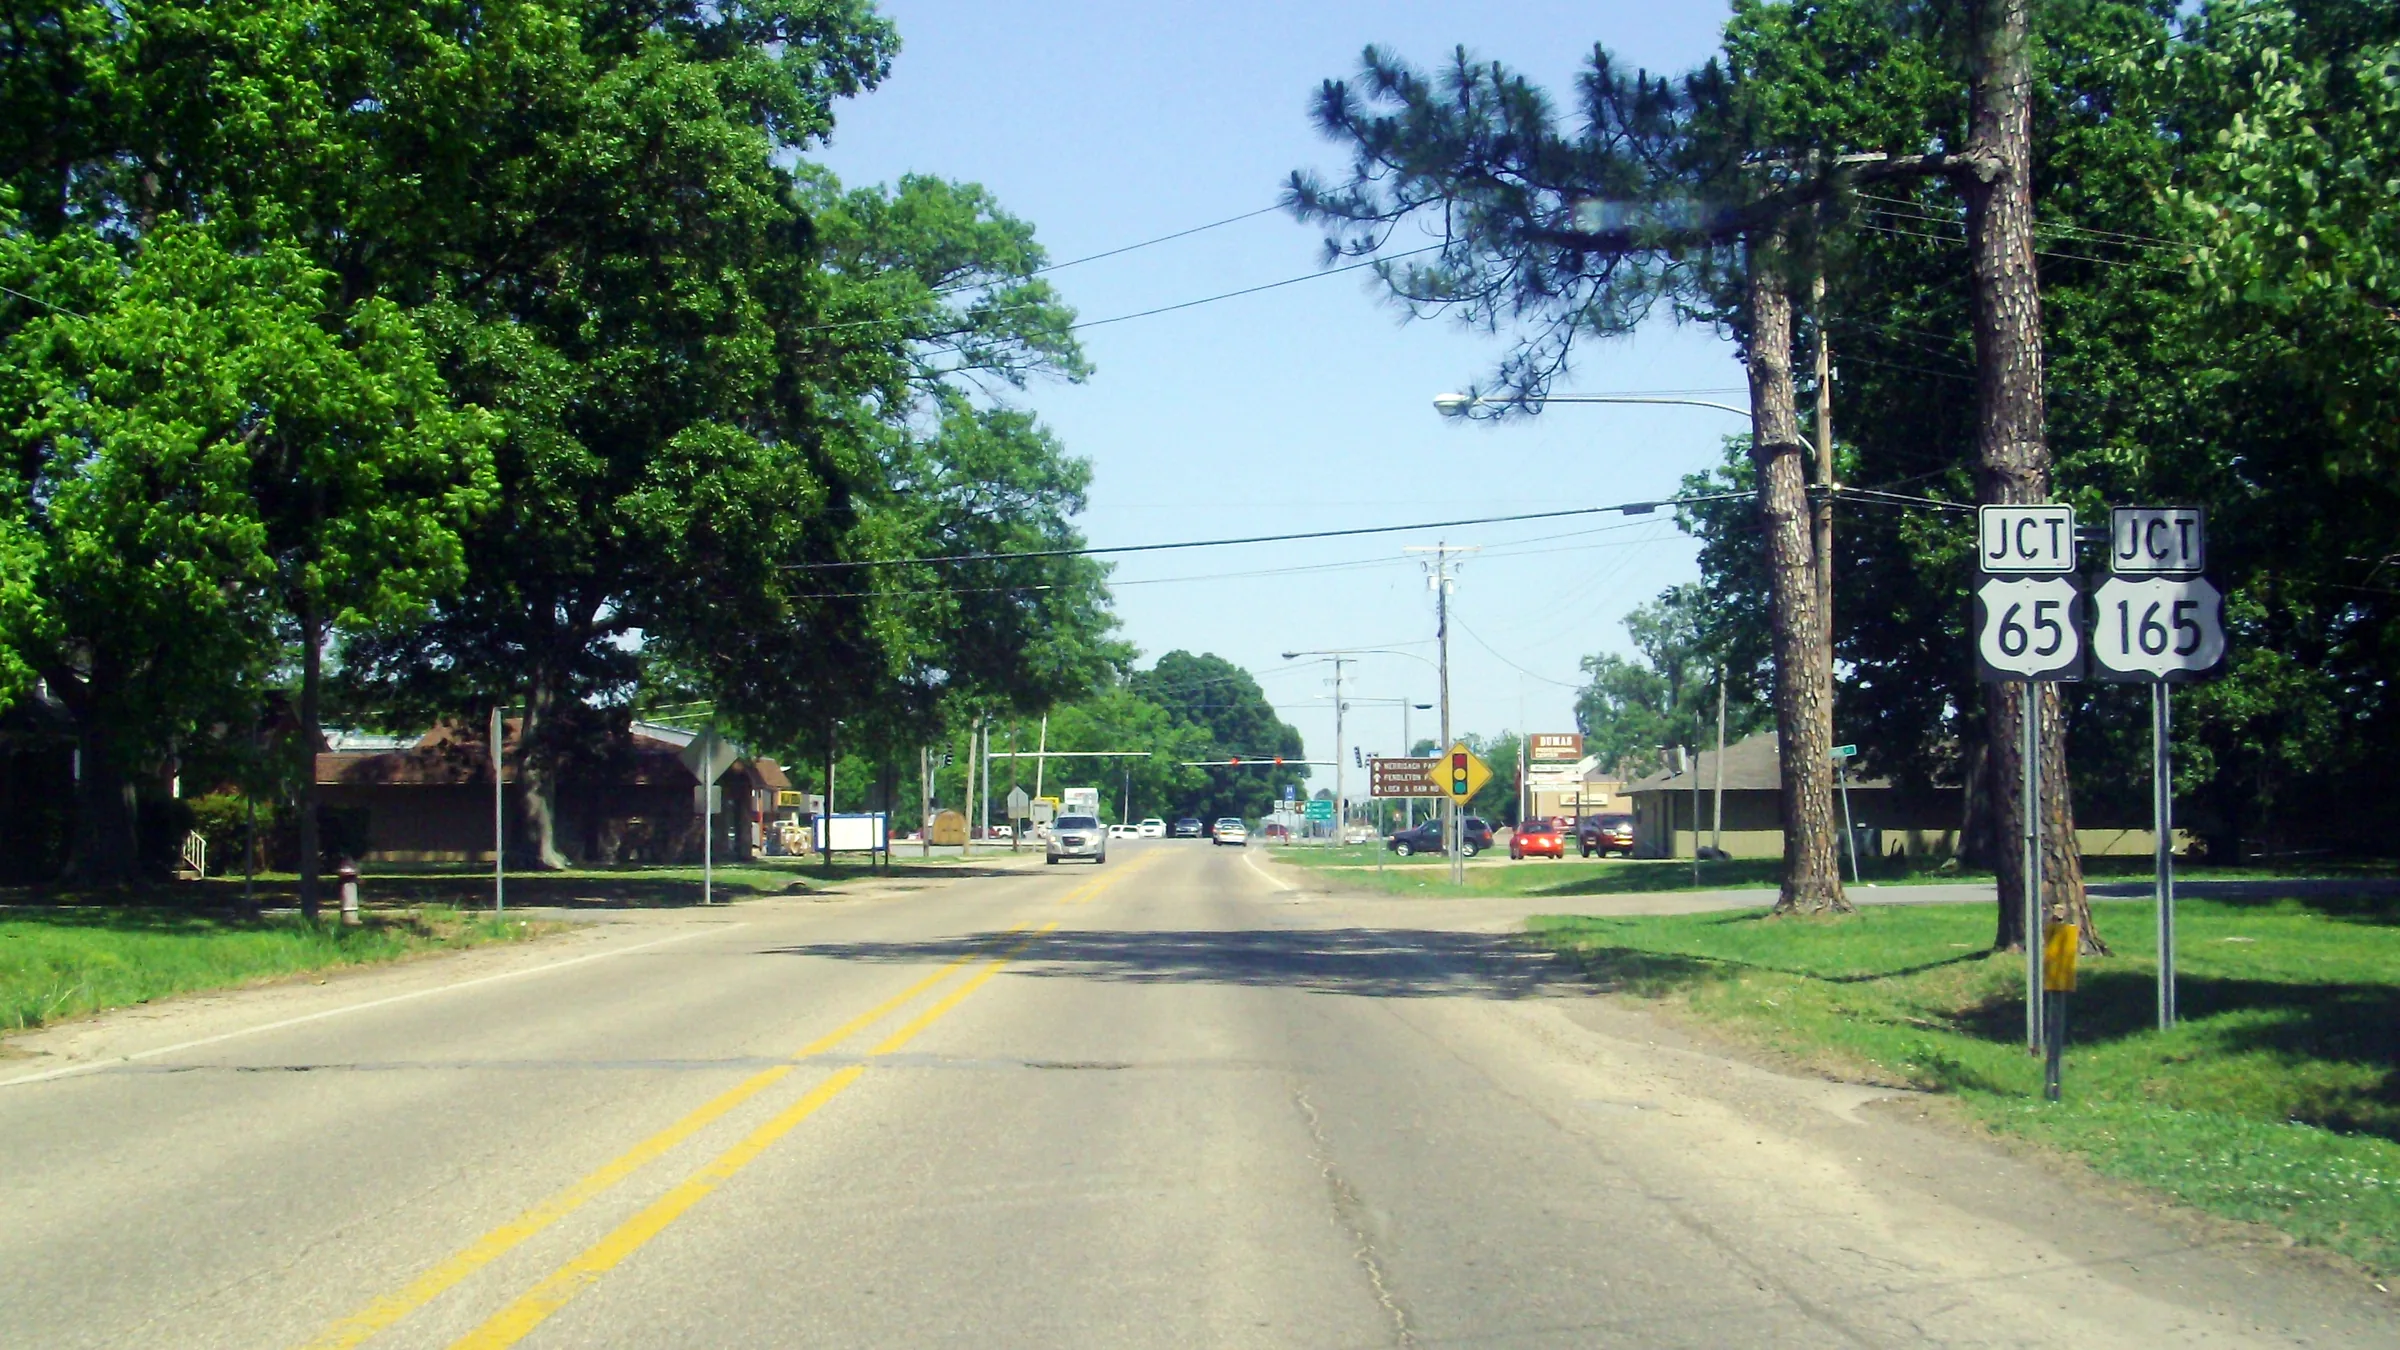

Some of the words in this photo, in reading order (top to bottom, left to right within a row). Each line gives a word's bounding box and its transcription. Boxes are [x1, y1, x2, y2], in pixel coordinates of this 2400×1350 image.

[1989, 517, 2064, 560] JCT
[2119, 517, 2195, 560] JCT
[1998, 600, 2063, 657] 65
[2117, 599, 2201, 656] 165
[1540, 736, 1573, 746] DUMAS
